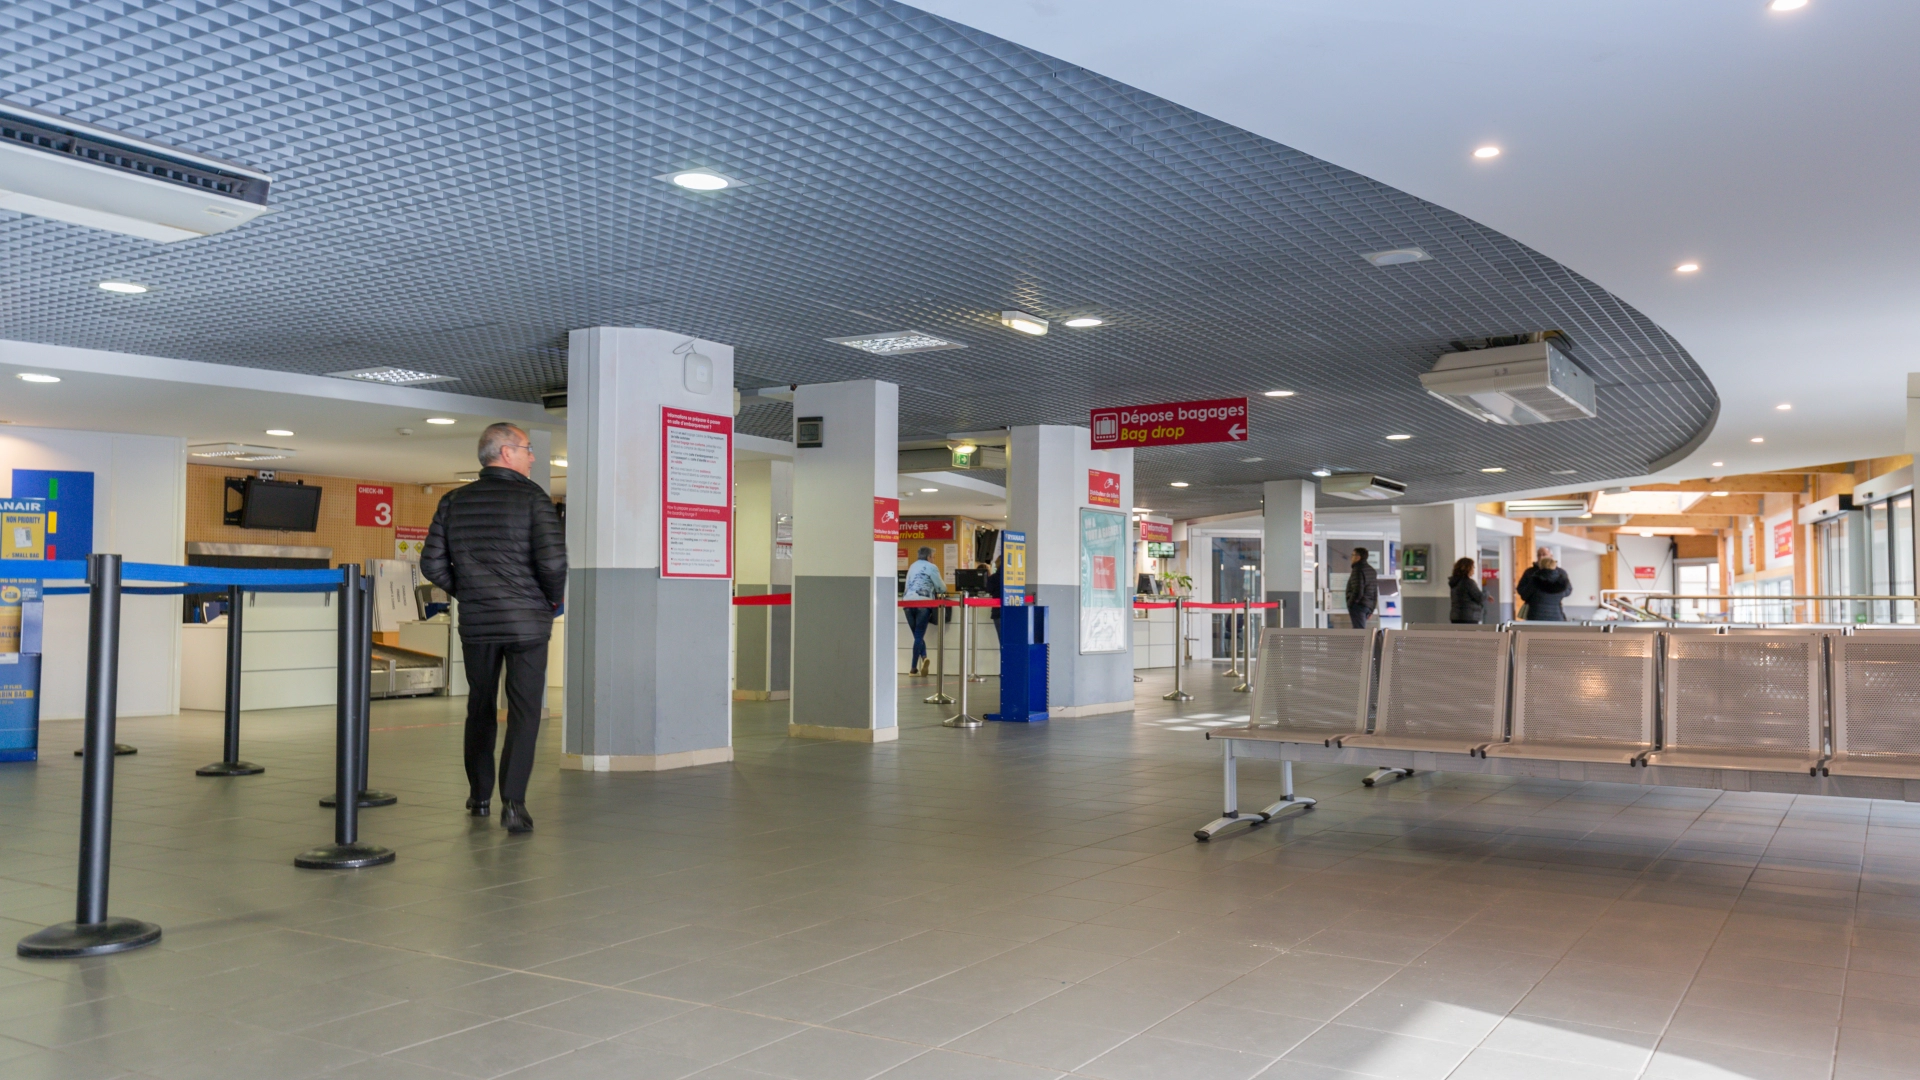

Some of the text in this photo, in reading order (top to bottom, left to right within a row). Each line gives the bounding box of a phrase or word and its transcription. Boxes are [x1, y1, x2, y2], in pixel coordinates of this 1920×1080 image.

[1121, 406, 1244, 426] Dépose bagages
[1120, 426, 1184, 442] Bag drop
[358, 486, 383, 495] CHECK-IN
[375, 503, 391, 525] 3
[899, 522, 928, 530] rrivées
